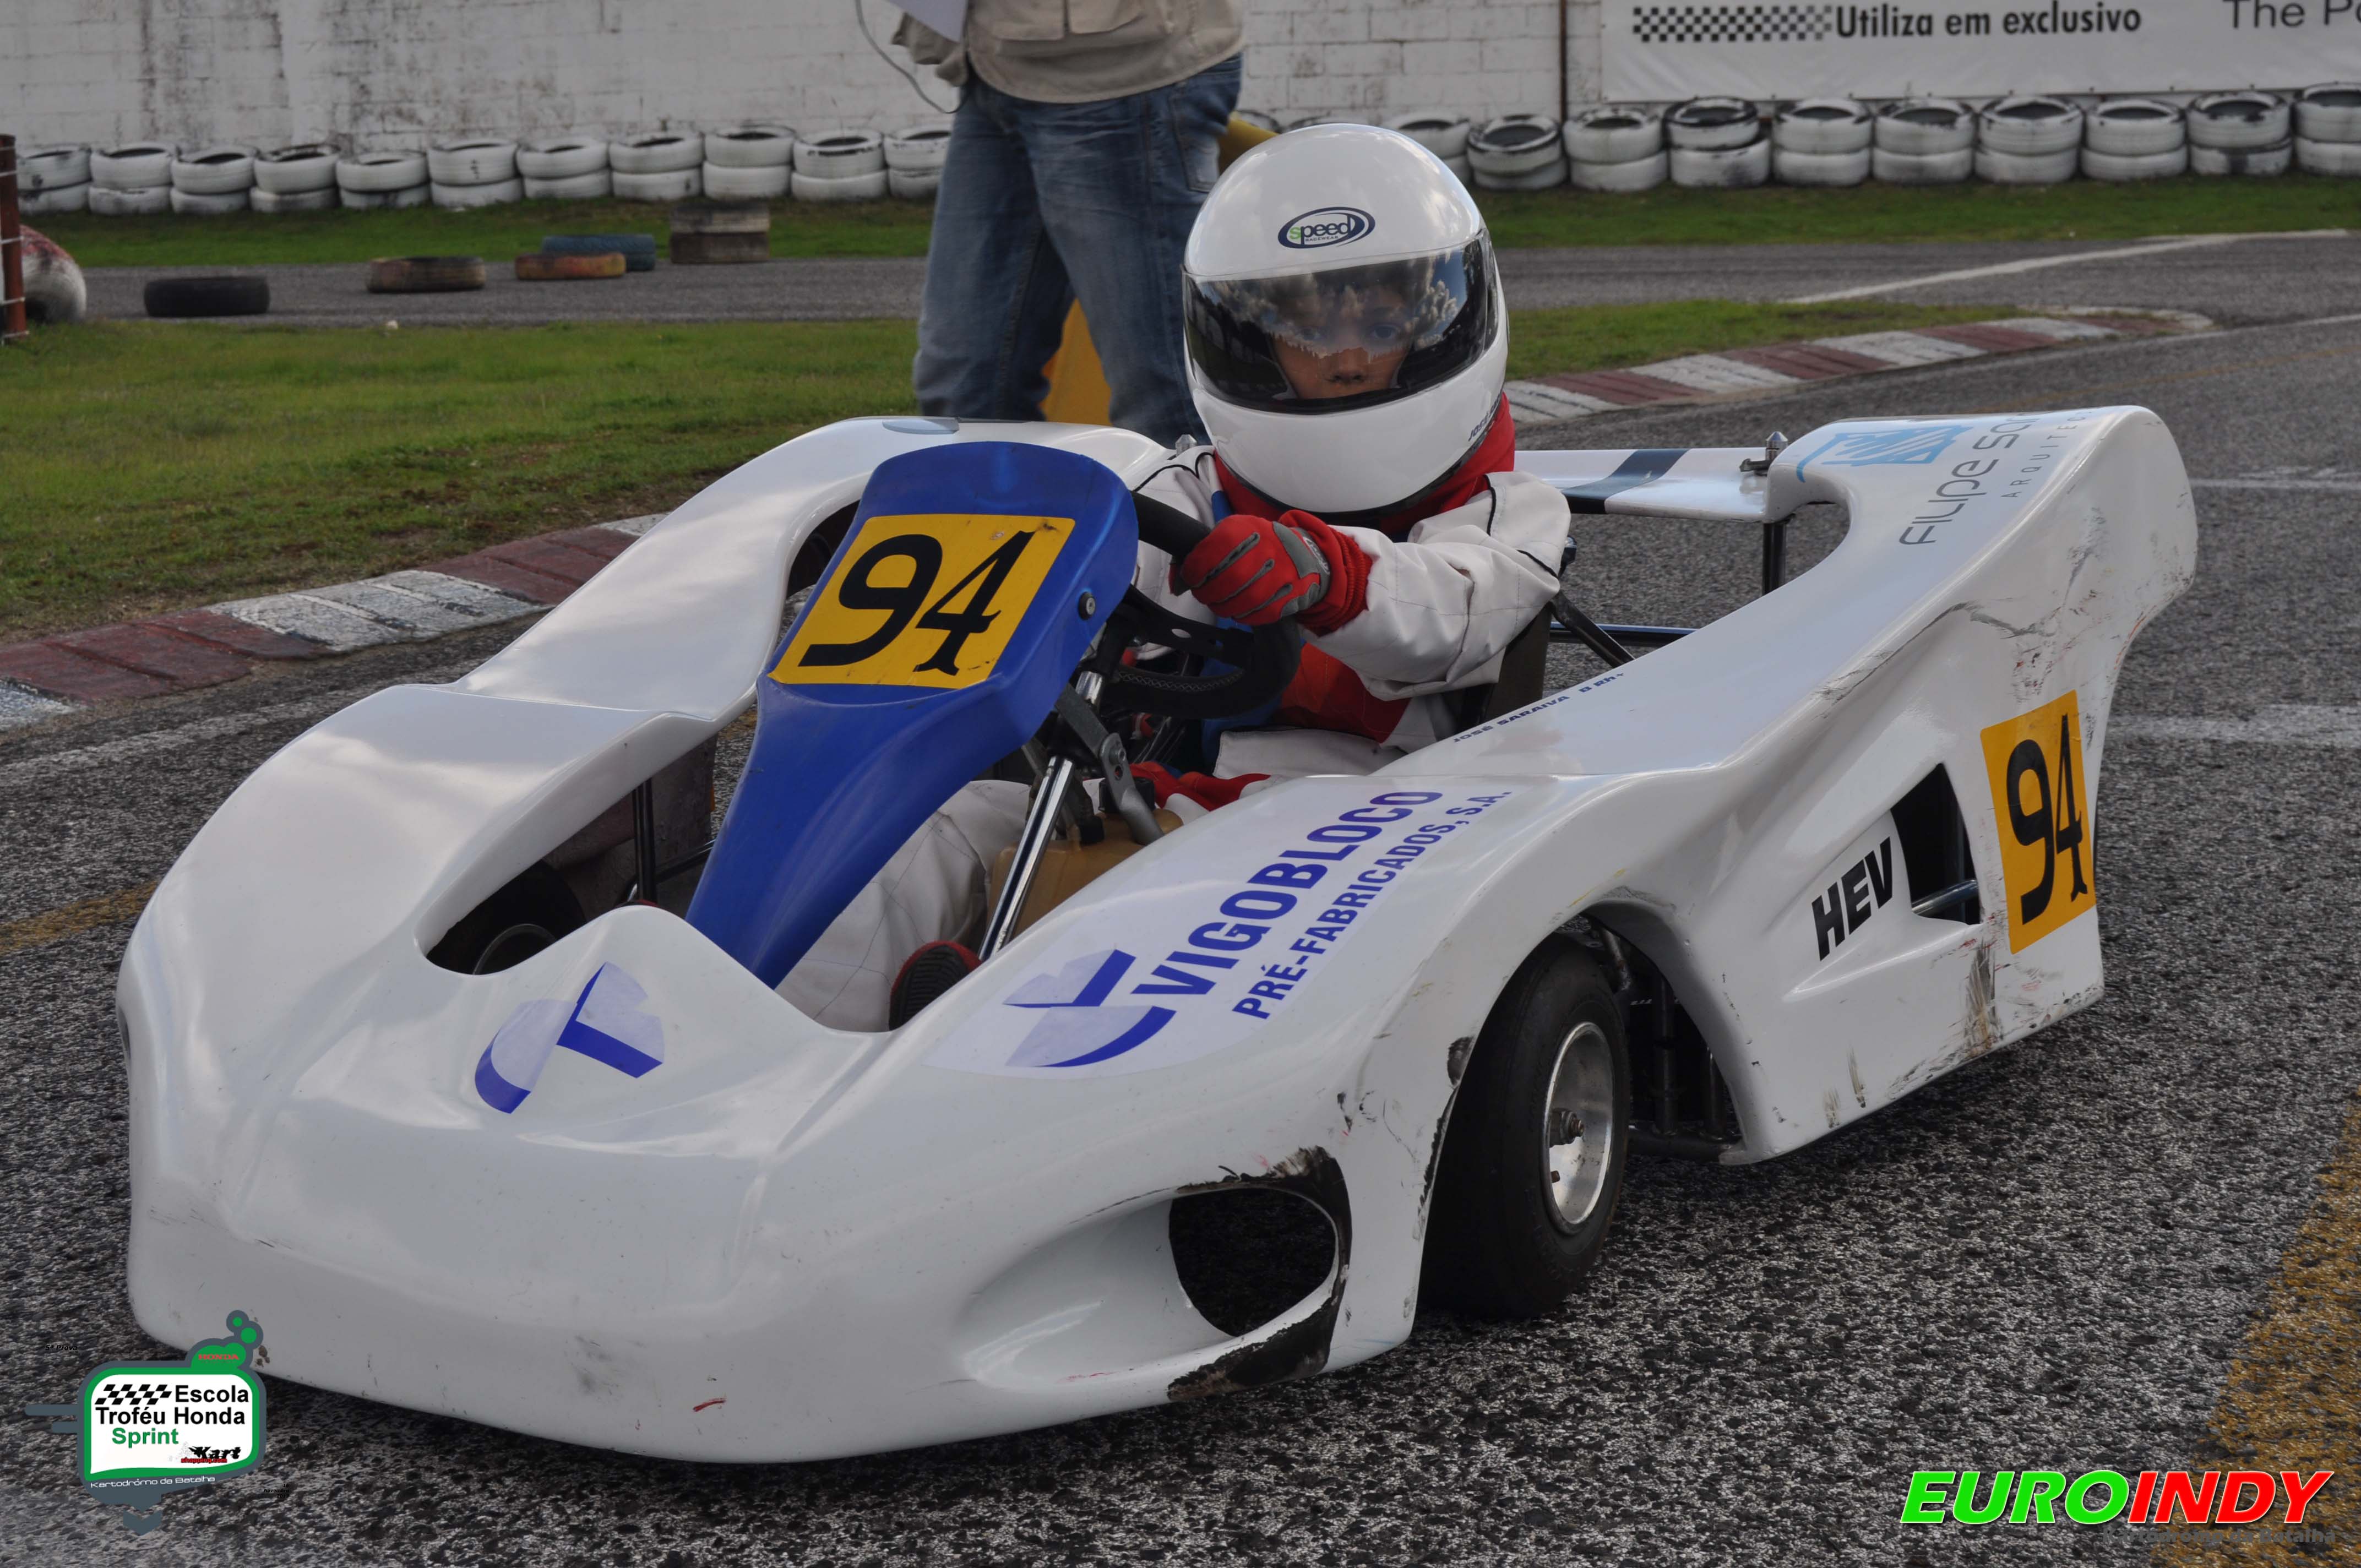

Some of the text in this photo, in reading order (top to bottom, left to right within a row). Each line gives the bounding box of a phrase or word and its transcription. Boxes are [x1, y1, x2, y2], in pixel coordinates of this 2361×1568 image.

[1836, 1, 2142, 38] Utiliza em exclusivo
[2222, 0, 2361, 29] The P
[1289, 215, 1352, 245] speed
[2001, 411, 2092, 498] ARQUITEC
[798, 530, 1035, 676] 94
[1497, 695, 1571, 726] SARAIVA
[2006, 714, 2088, 925] 94
[1130, 791, 1443, 995] VIGOBLOCO
[1232, 792, 1513, 1019] PRÉ-FABRICADOS, S.A.
[1811, 836, 1892, 962] HEV
